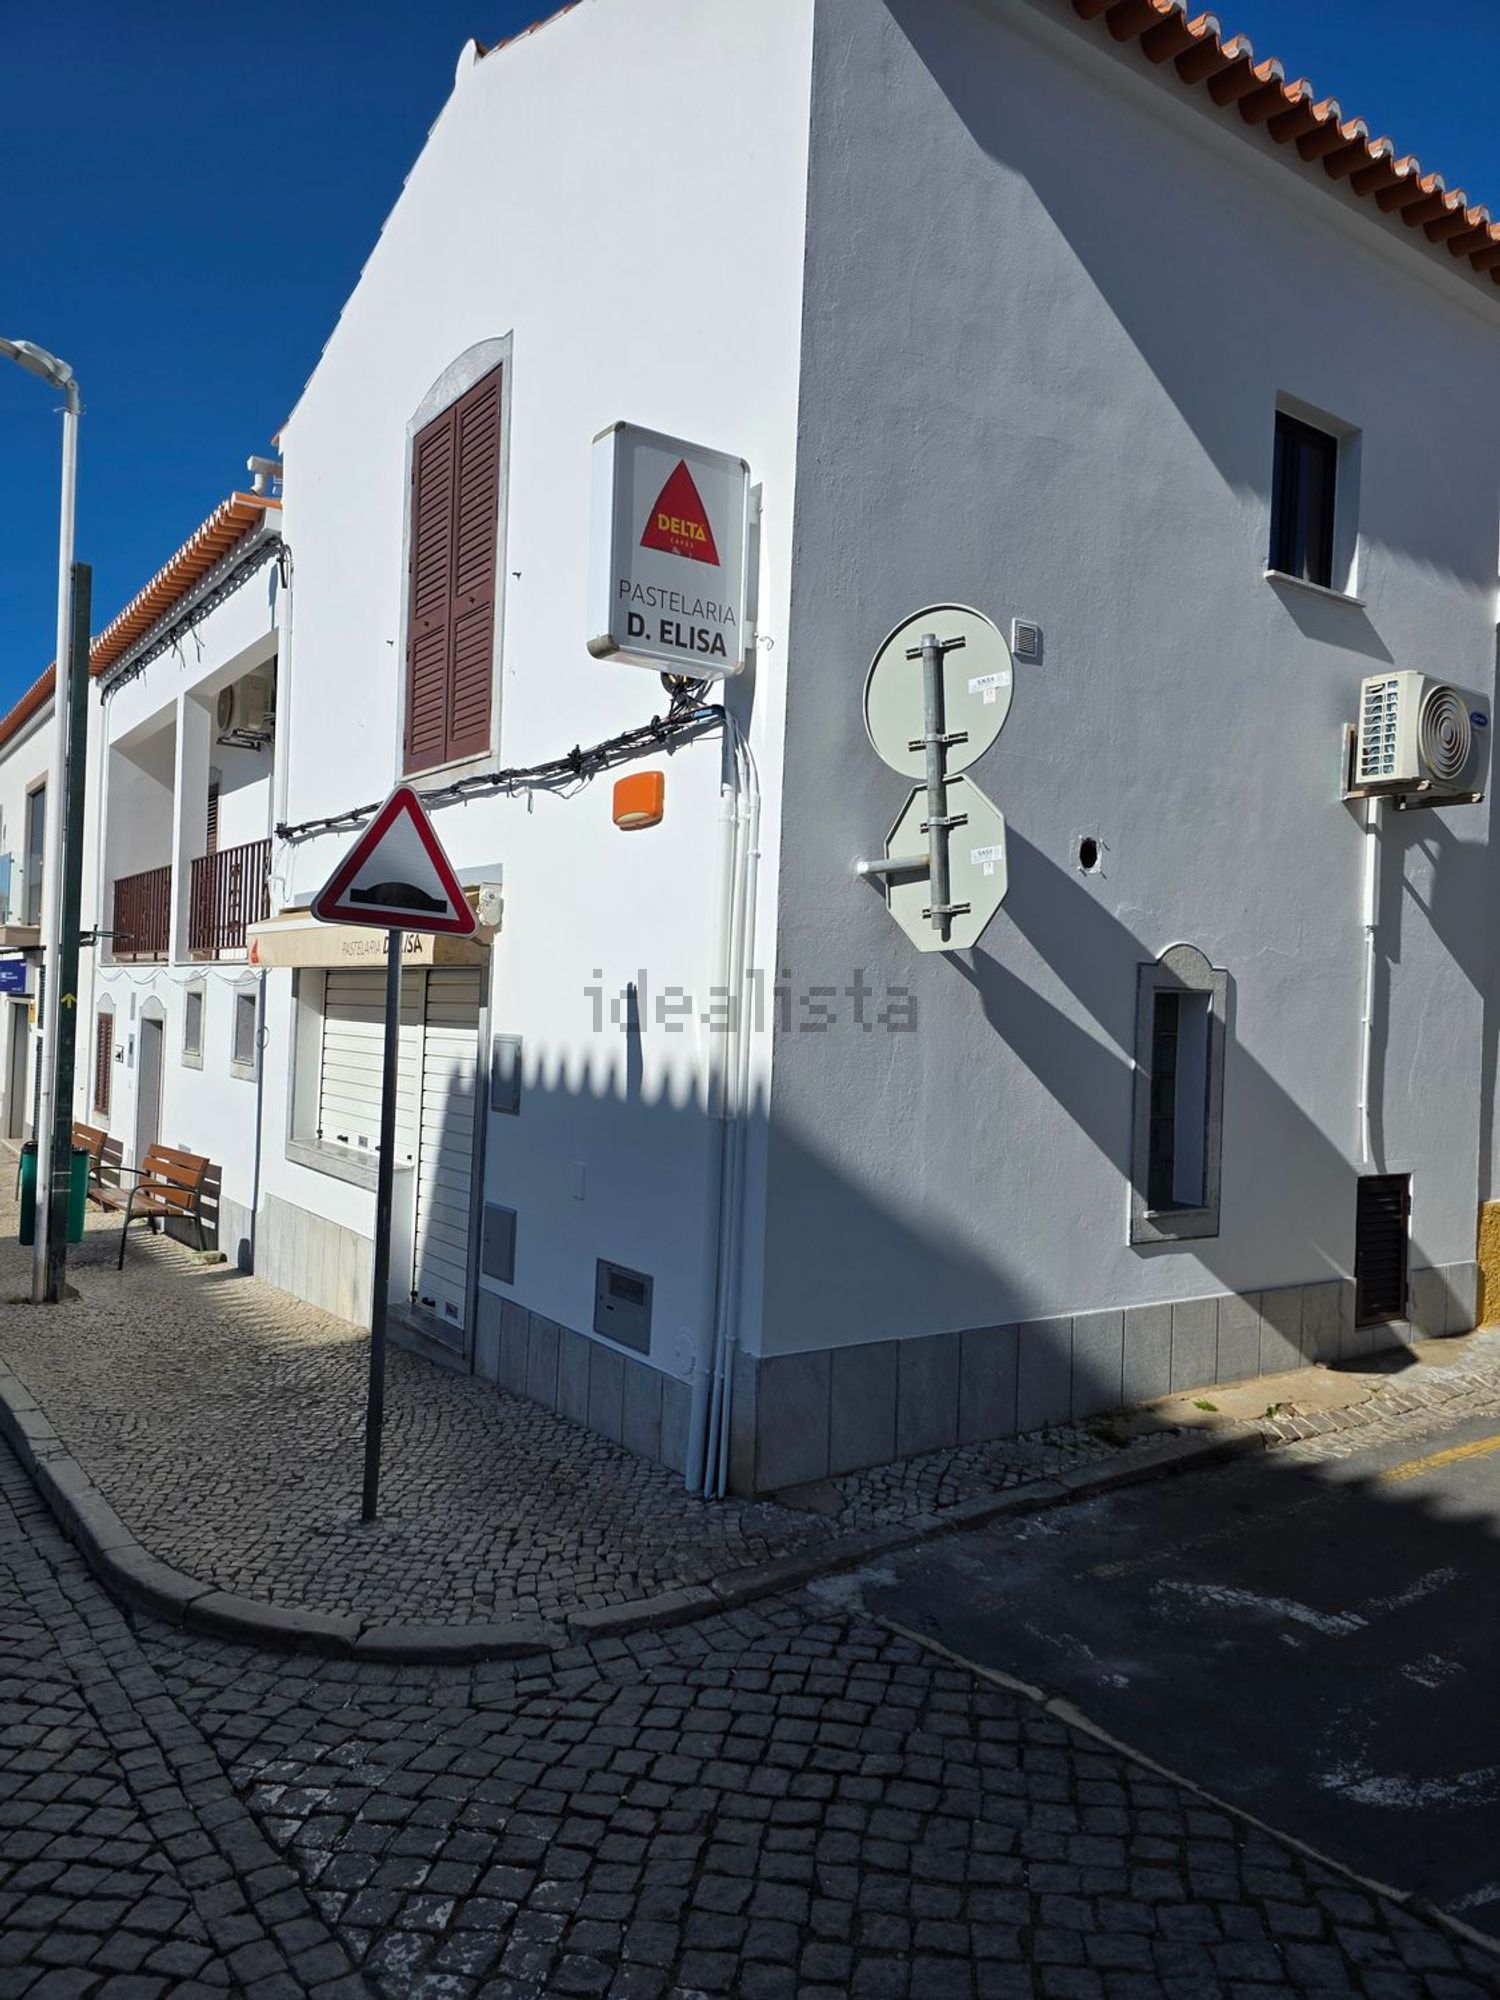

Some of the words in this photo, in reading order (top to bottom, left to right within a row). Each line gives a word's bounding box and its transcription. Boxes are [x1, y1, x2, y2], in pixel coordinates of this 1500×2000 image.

[658, 513, 707, 542] DELTA
[619, 579, 736, 626] PASTELARIA
[627, 611, 651, 640] D.
[659, 618, 727, 657] ELISA
